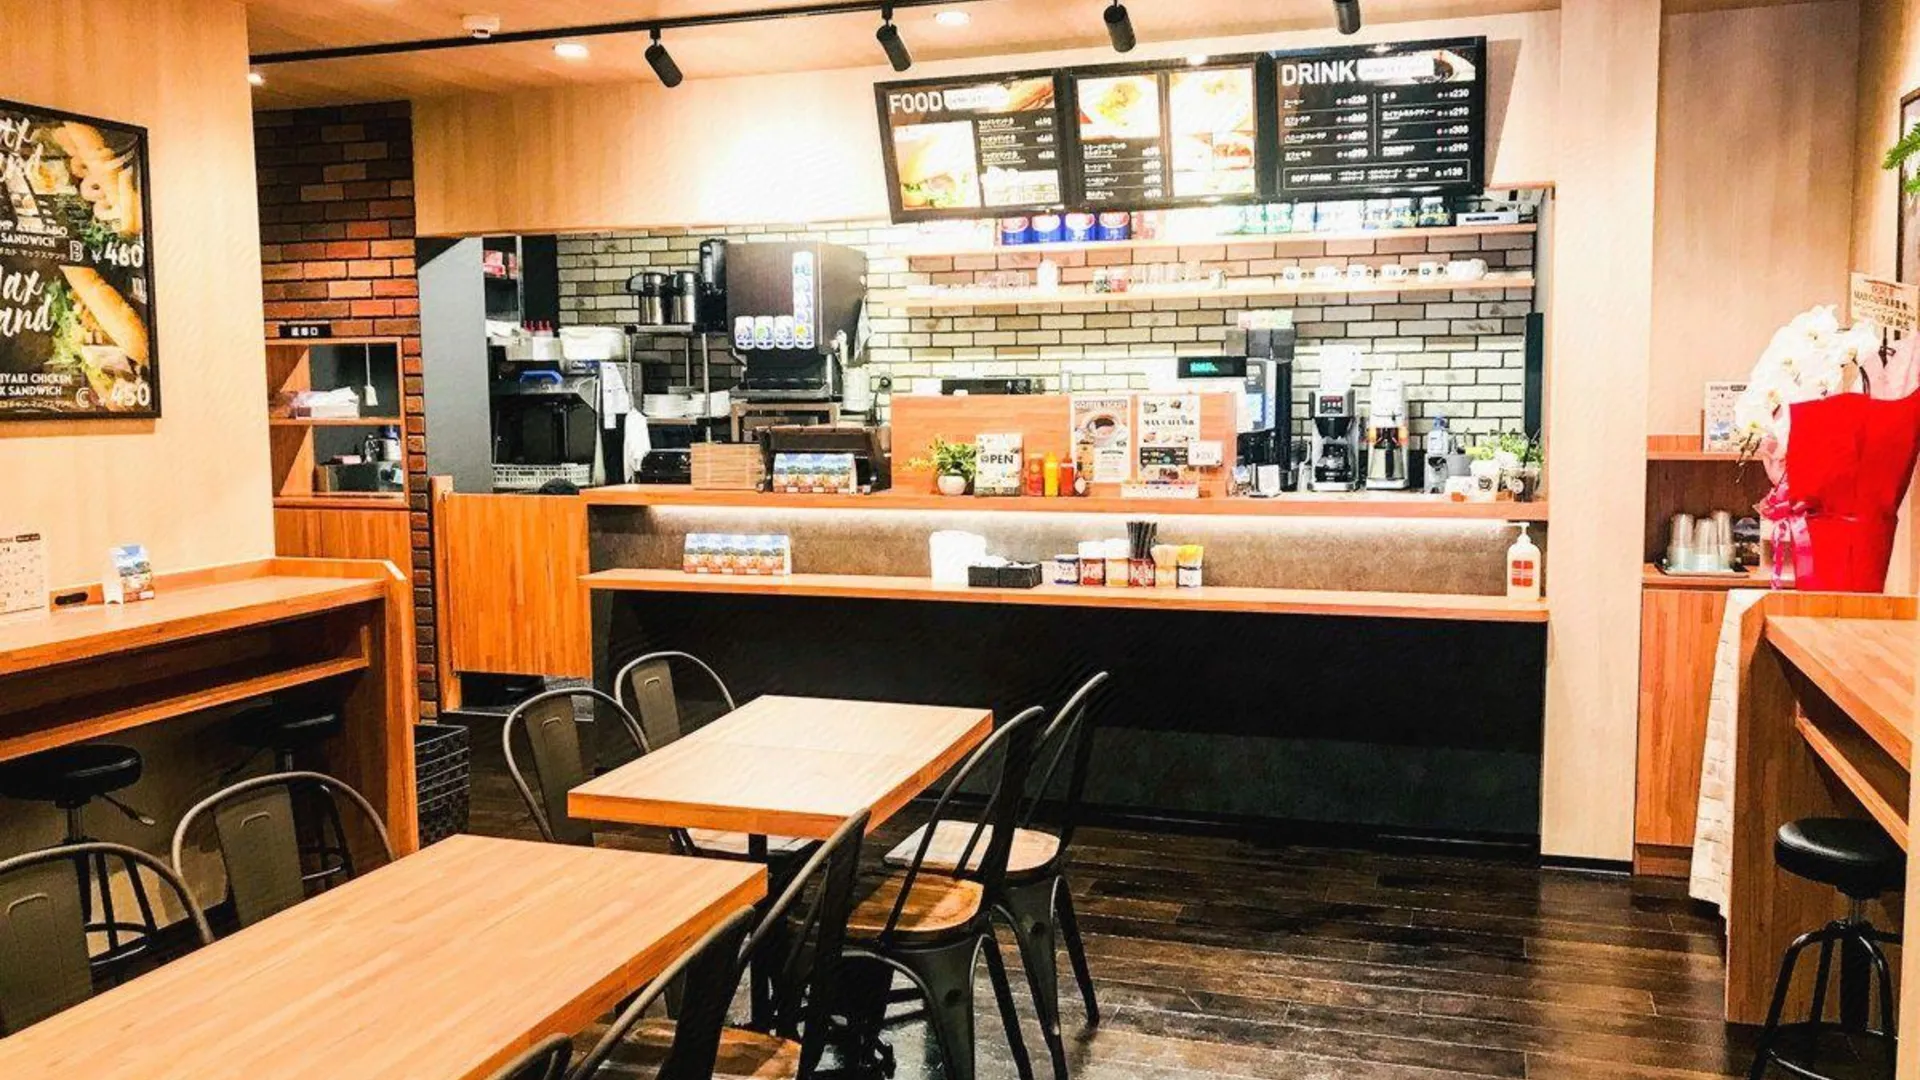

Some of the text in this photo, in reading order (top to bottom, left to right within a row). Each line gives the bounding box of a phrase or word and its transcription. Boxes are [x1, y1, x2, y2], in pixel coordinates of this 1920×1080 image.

[1281, 59, 1356, 86] DRINK
[889, 91, 942, 113] FOOD
[1, 233, 56, 248] SANDWICH
[30, 373, 73, 385] CHICKEN
[8, 385, 63, 397] SANDWICH
[980, 454, 1014, 465] OPEN
